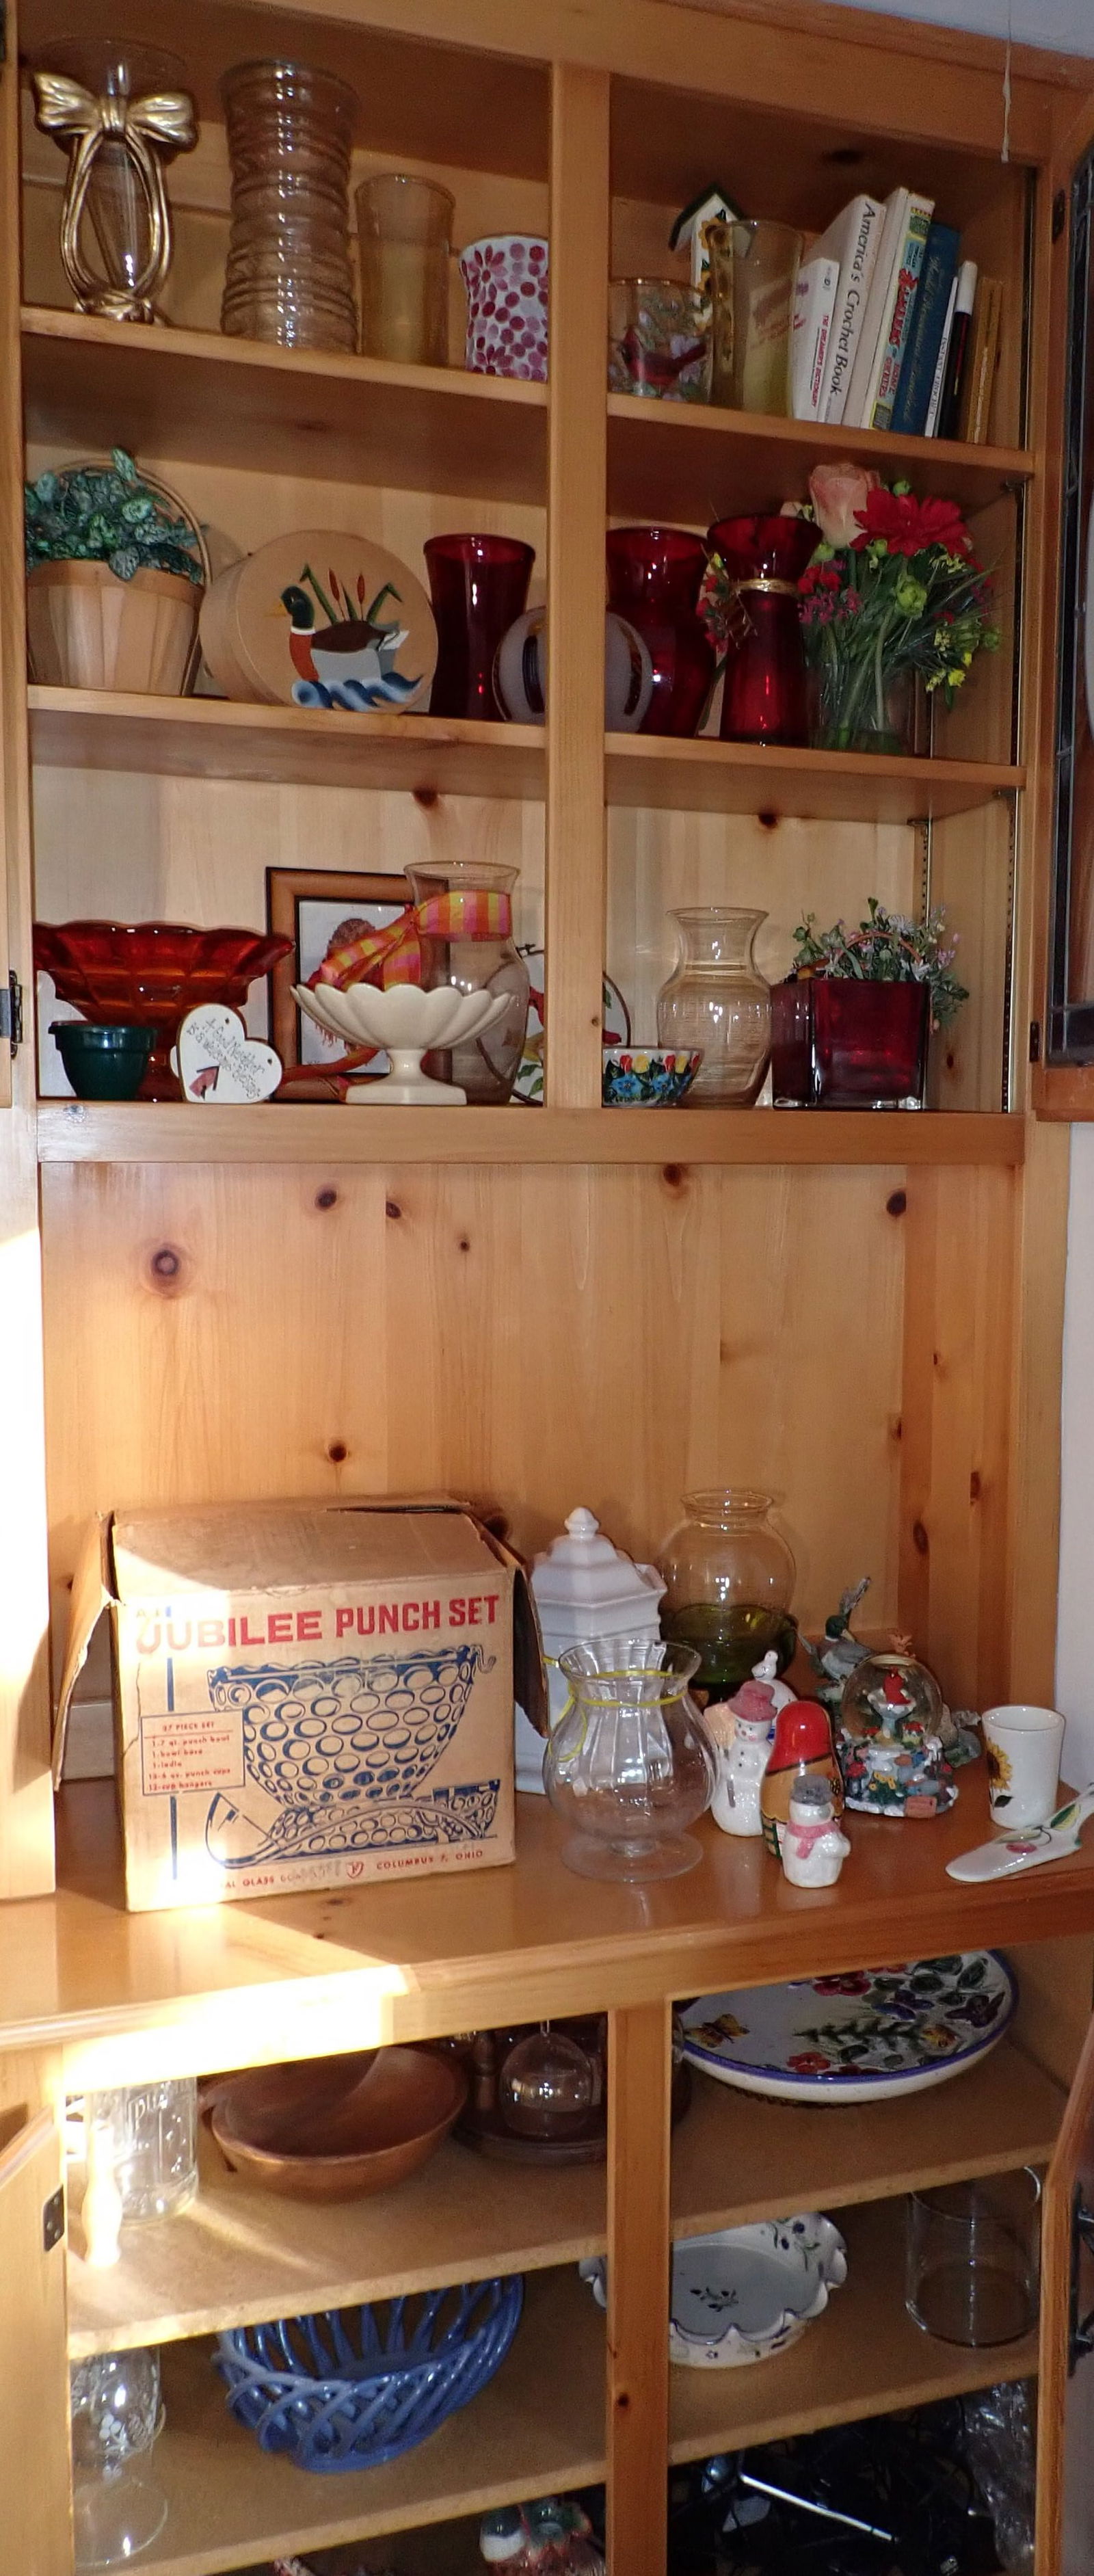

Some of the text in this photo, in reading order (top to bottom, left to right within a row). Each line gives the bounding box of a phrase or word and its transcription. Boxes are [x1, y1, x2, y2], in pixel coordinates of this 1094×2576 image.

[829, 203, 876, 396] America's Crochet Book
[811, 367, 822, 408] DICTIONARY
[137, 1595, 500, 1654] JUBILEE PUNCH SET
[176, 1722, 198, 1731] PIECE
[201, 1721, 215, 1729] SET
[183, 1736, 207, 1746] punch
[210, 1735, 230, 1743] bowl
[185, 1769, 210, 1779] punch
[213, 1768, 230, 1776] cups
[178, 1779, 213, 1790] hangers
[376, 1856, 433, 1870] COLUMBUS
[455, 1850, 483, 1861] OHIO
[243, 1876, 274, 1887] GLASS
